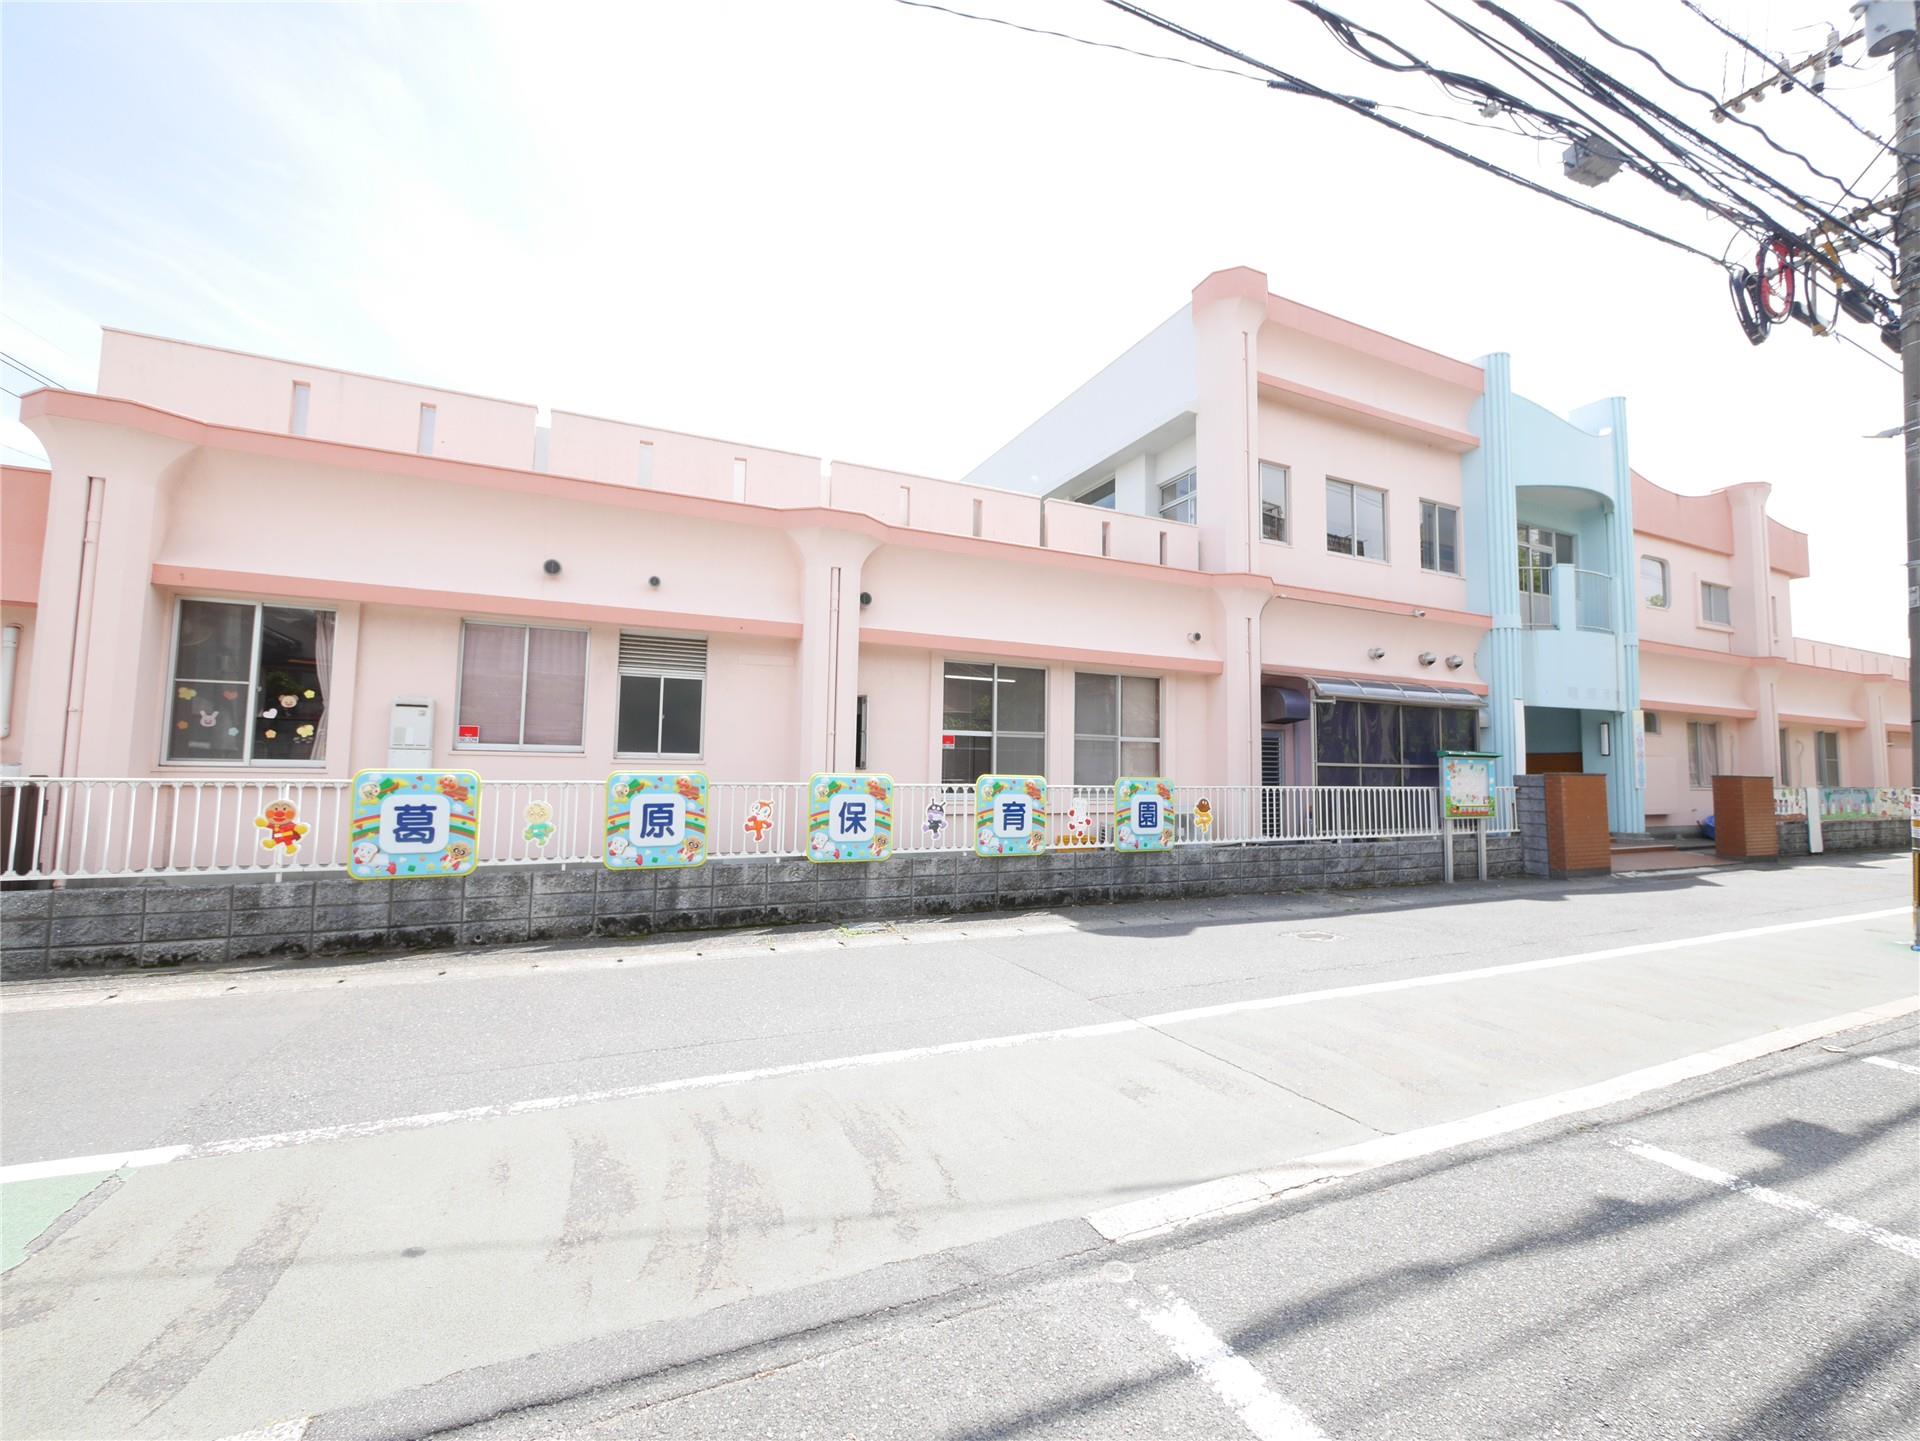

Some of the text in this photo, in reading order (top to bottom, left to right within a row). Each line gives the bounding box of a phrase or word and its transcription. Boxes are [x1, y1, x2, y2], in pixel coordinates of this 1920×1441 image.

[393, 801, 1158, 844] 葛 原 保 育 園
